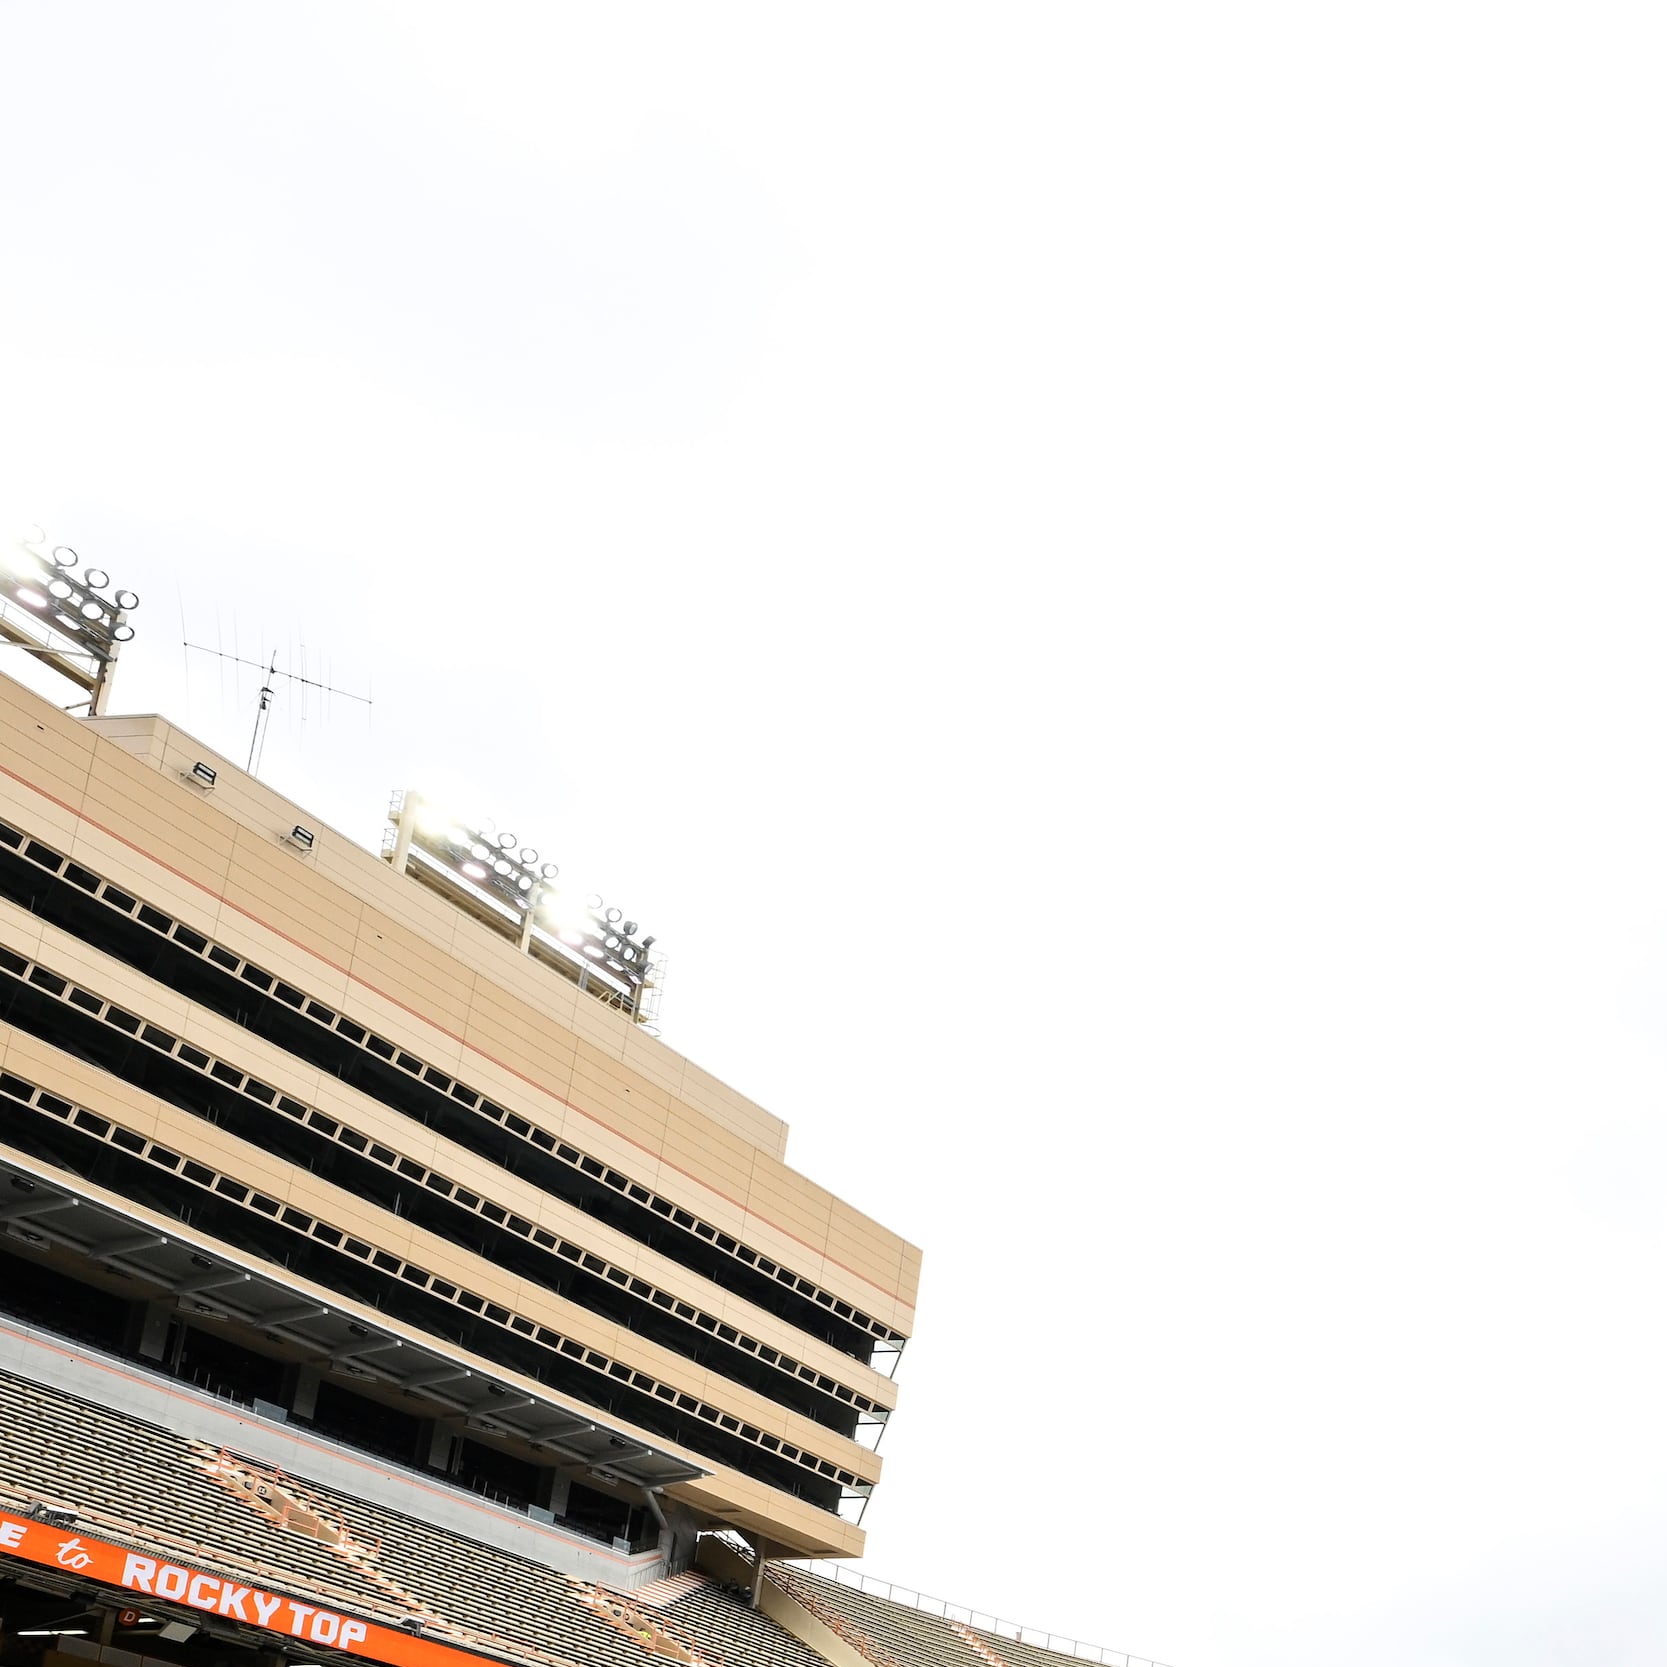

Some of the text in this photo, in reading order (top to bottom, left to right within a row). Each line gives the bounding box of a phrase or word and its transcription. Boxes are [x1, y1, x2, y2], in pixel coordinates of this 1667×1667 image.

[54, 1538, 94, 1569] to
[121, 1553, 281, 1627] ROCKY
[287, 1602, 368, 1649] TOP
[124, 1610, 136, 1623] D
